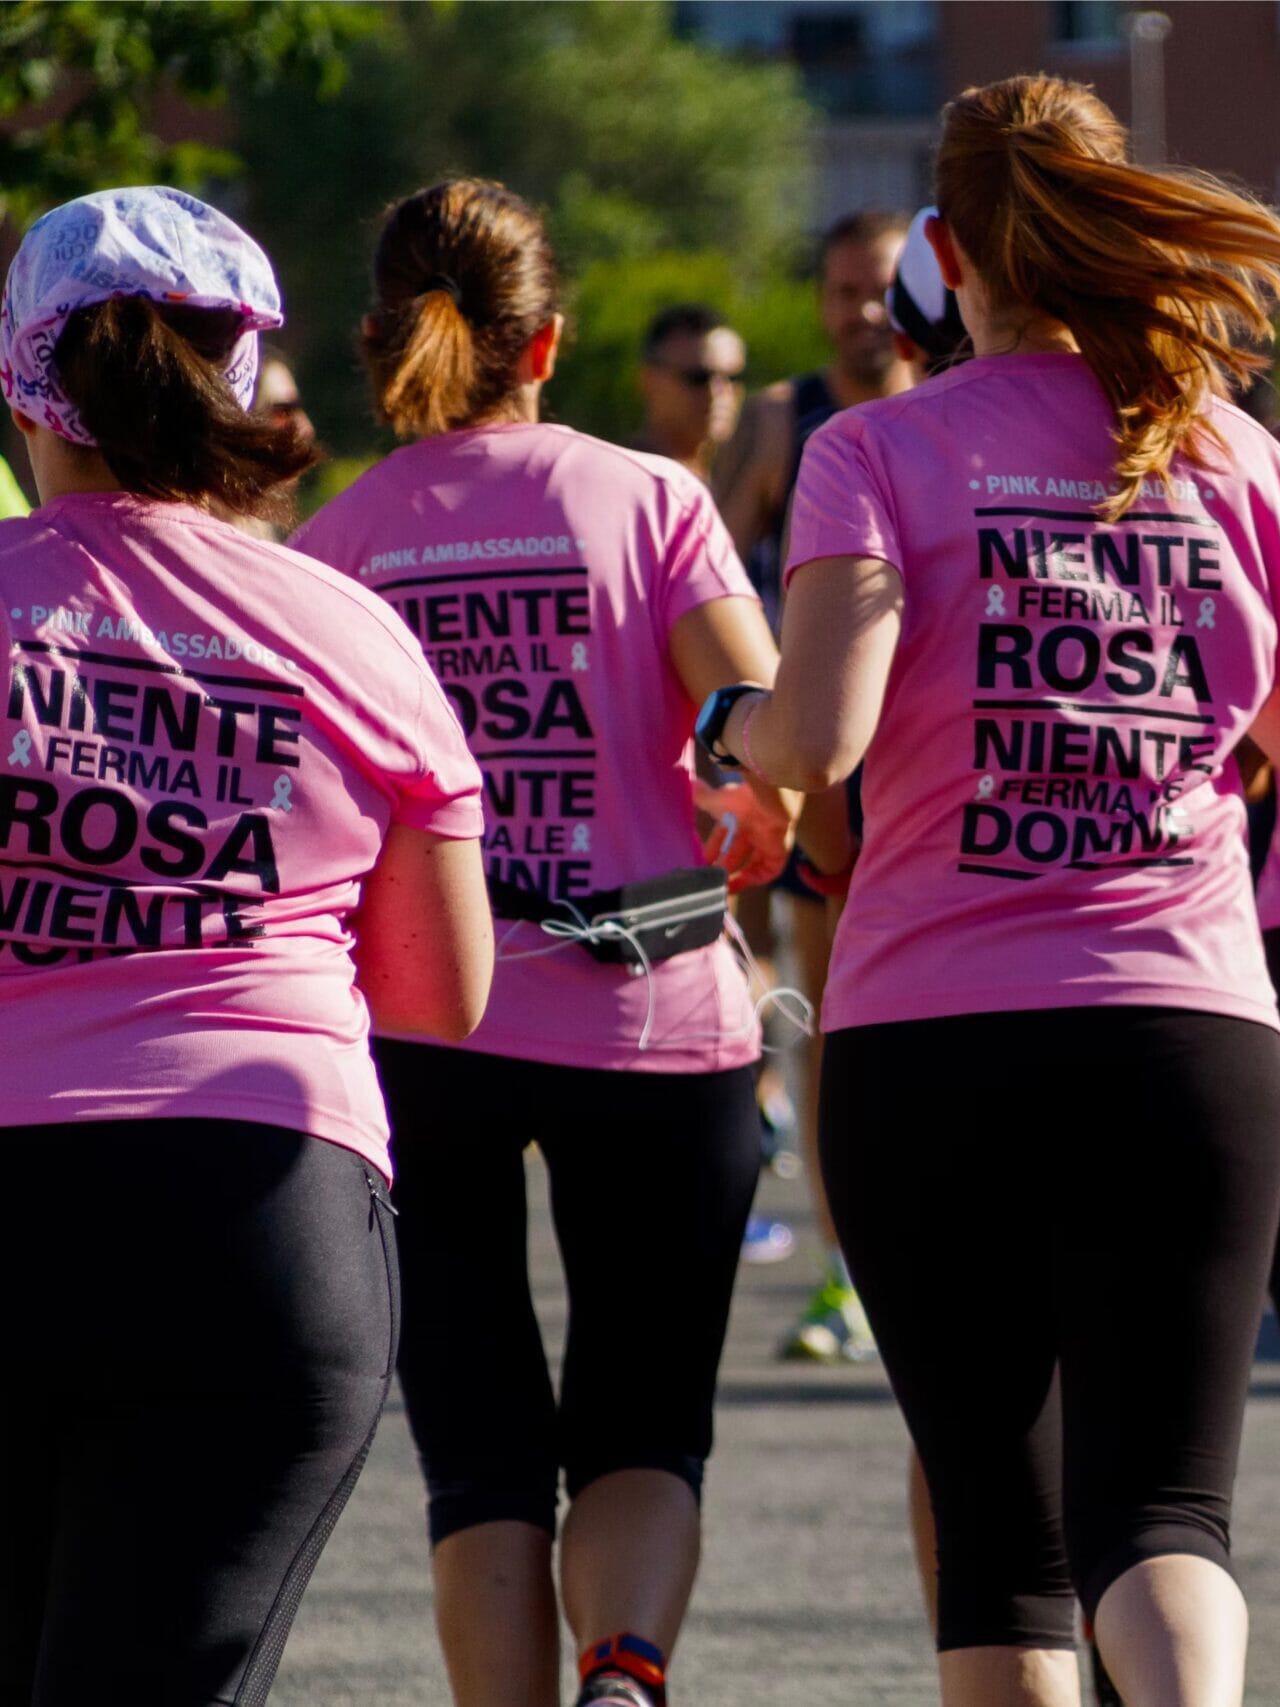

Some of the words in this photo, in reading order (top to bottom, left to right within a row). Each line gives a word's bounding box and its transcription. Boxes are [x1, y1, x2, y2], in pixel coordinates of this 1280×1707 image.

[986, 475, 1040, 496] PINK
[1044, 477, 1200, 505] AMBAADOR
[370, 547, 417, 575] PINK
[421, 535, 570, 565] AMBASSADOR
[977, 528, 1223, 591] NIENTE
[31, 605, 92, 637] PINK
[97, 608, 280, 667] AMBASSADOR
[398, 587, 592, 645] IENTE
[1018, 586, 1150, 628] FERMA
[1161, 590, 1185, 627] IL
[531, 645, 560, 672] IL
[976, 623, 1213, 703] ROSA
[8, 662, 304, 768] NIENTE
[444, 679, 595, 742] OSA
[45, 736, 202, 798] FERMA
[217, 765, 254, 806] IL
[972, 719, 1216, 780] NIENTE
[1000, 779, 1136, 816] FERMA
[0, 775, 281, 894] ROSA
[524, 825, 565, 855] LE
